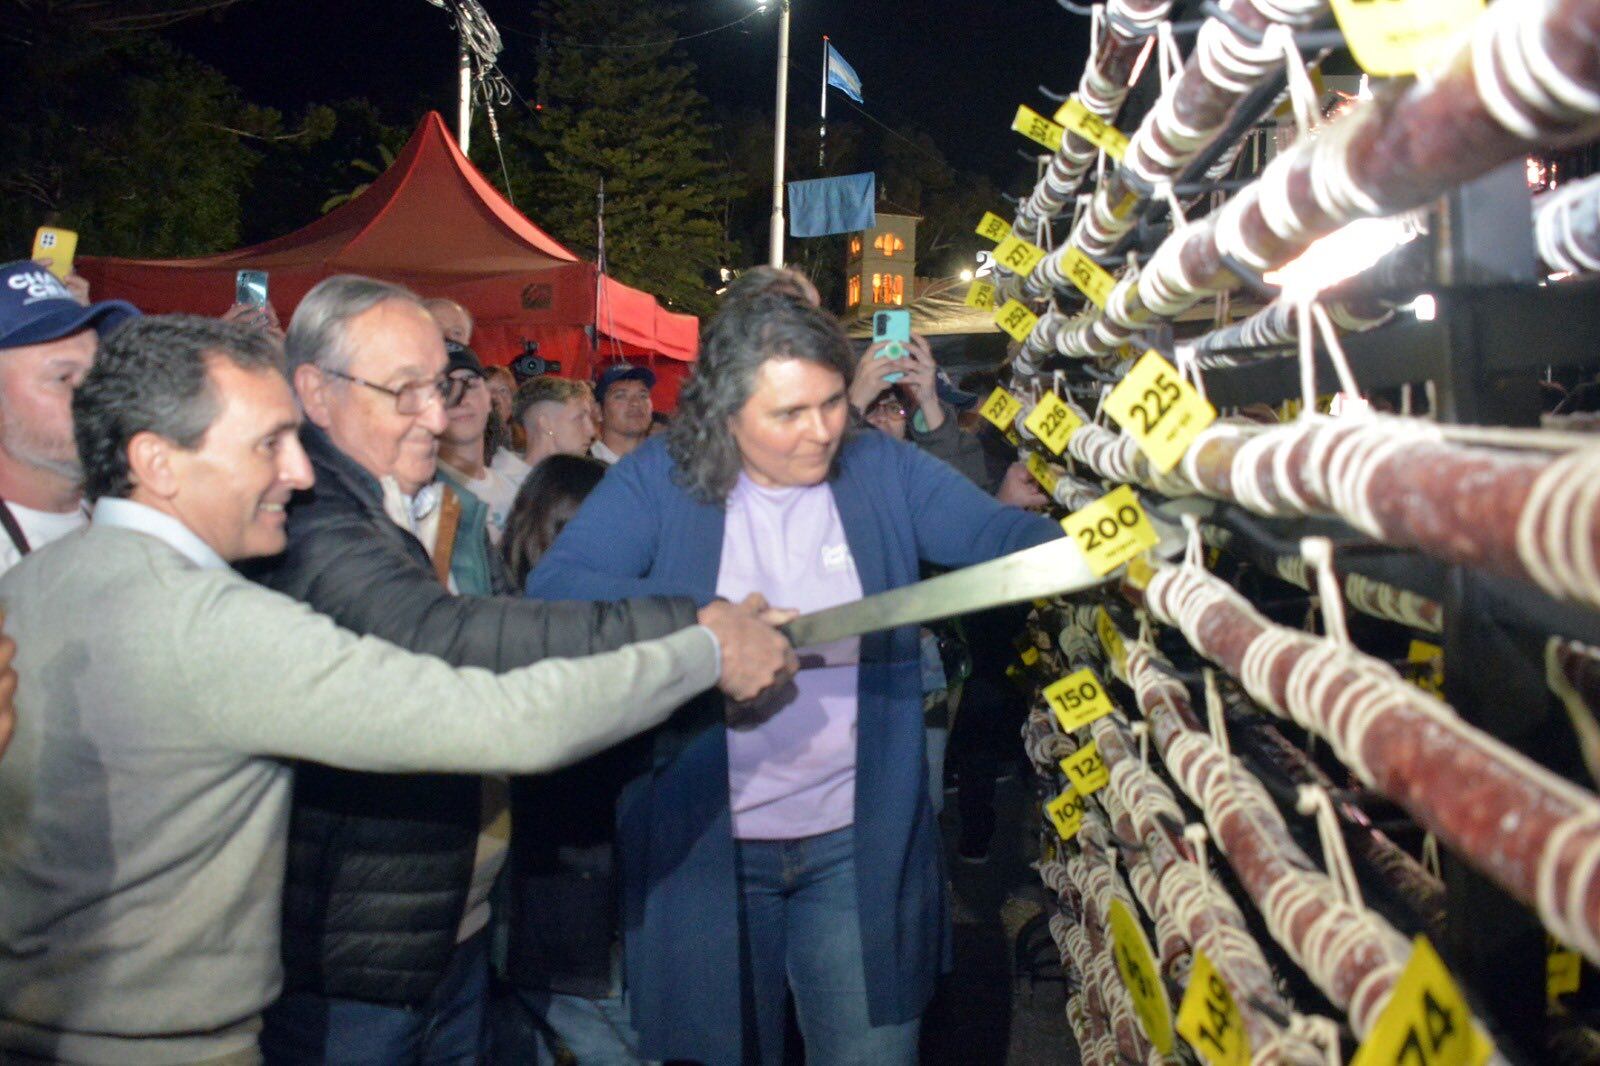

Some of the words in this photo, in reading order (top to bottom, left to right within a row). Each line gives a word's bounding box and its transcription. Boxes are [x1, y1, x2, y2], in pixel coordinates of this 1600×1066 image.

[1005, 243, 1030, 267] 277
[1003, 306, 1029, 329] 252
[989, 394, 1009, 419] 227
[1129, 373, 1181, 435] 225
[1039, 404, 1067, 437] 226
[1078, 505, 1140, 552] 200
[1055, 682, 1097, 712] 150
